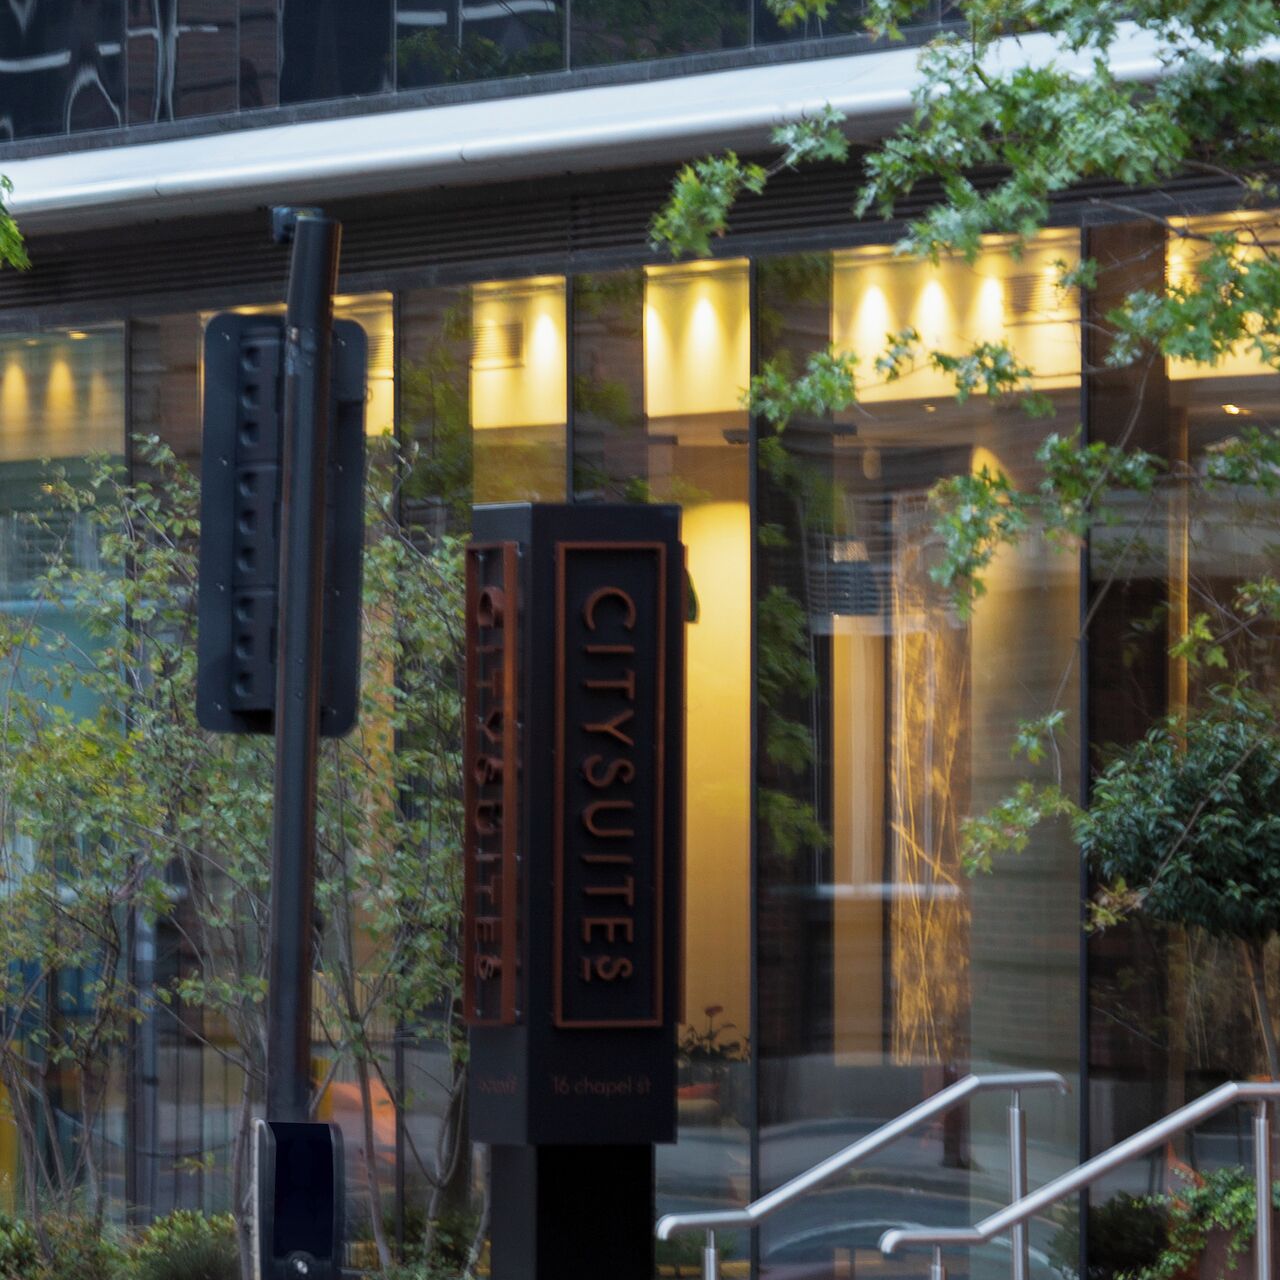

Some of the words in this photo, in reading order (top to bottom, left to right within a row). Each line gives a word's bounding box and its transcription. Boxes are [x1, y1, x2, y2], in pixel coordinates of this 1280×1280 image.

[581, 586, 637, 981] CITYSUITES
[552, 1075, 570, 1095] 16
[574, 1075, 631, 1098] chapel
[637, 1076, 652, 1095] st
